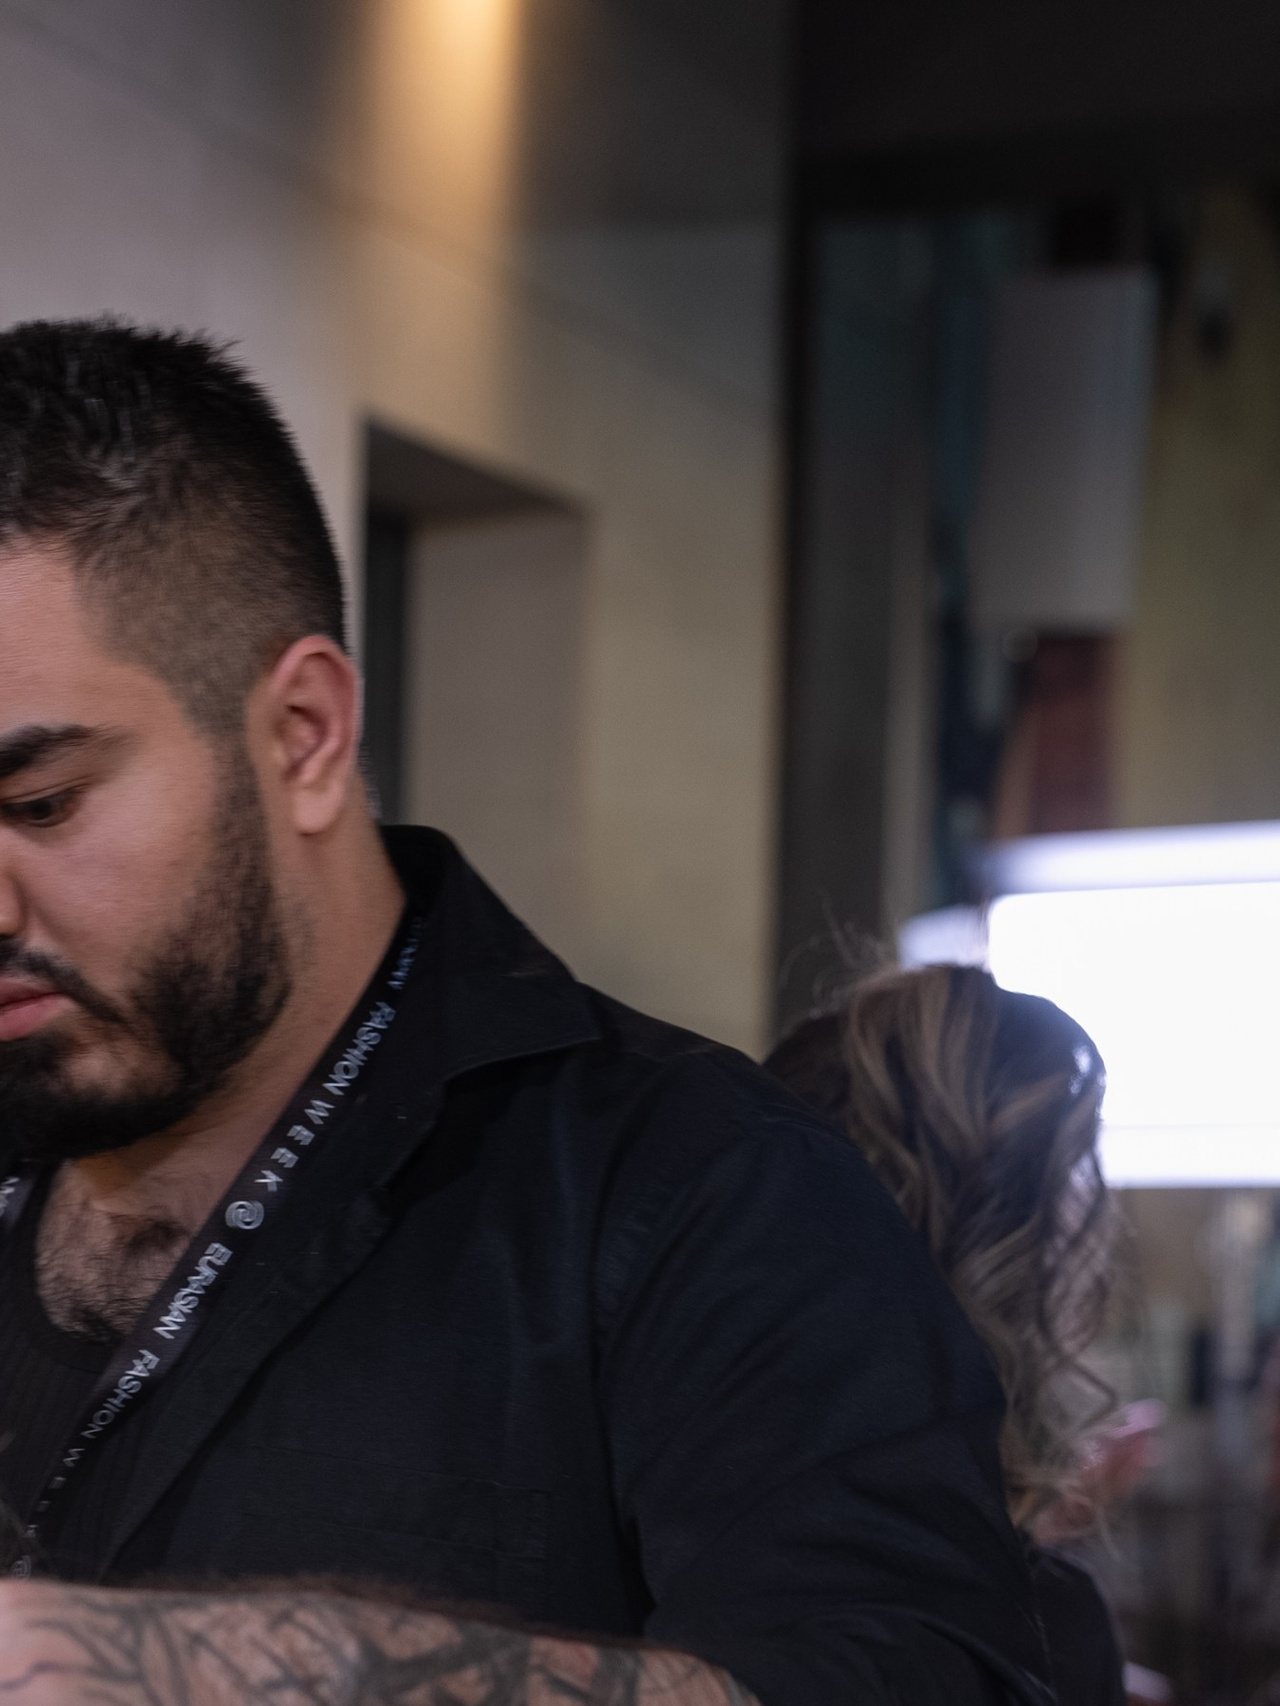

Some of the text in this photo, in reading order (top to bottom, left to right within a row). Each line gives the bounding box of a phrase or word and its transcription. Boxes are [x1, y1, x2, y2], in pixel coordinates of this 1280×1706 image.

[322, 1001, 397, 1096] FASHION
[254, 1099, 336, 1192] WEEK
[152, 1242, 234, 1340] EURASIAN
[80, 1349, 161, 1439] FASHION
